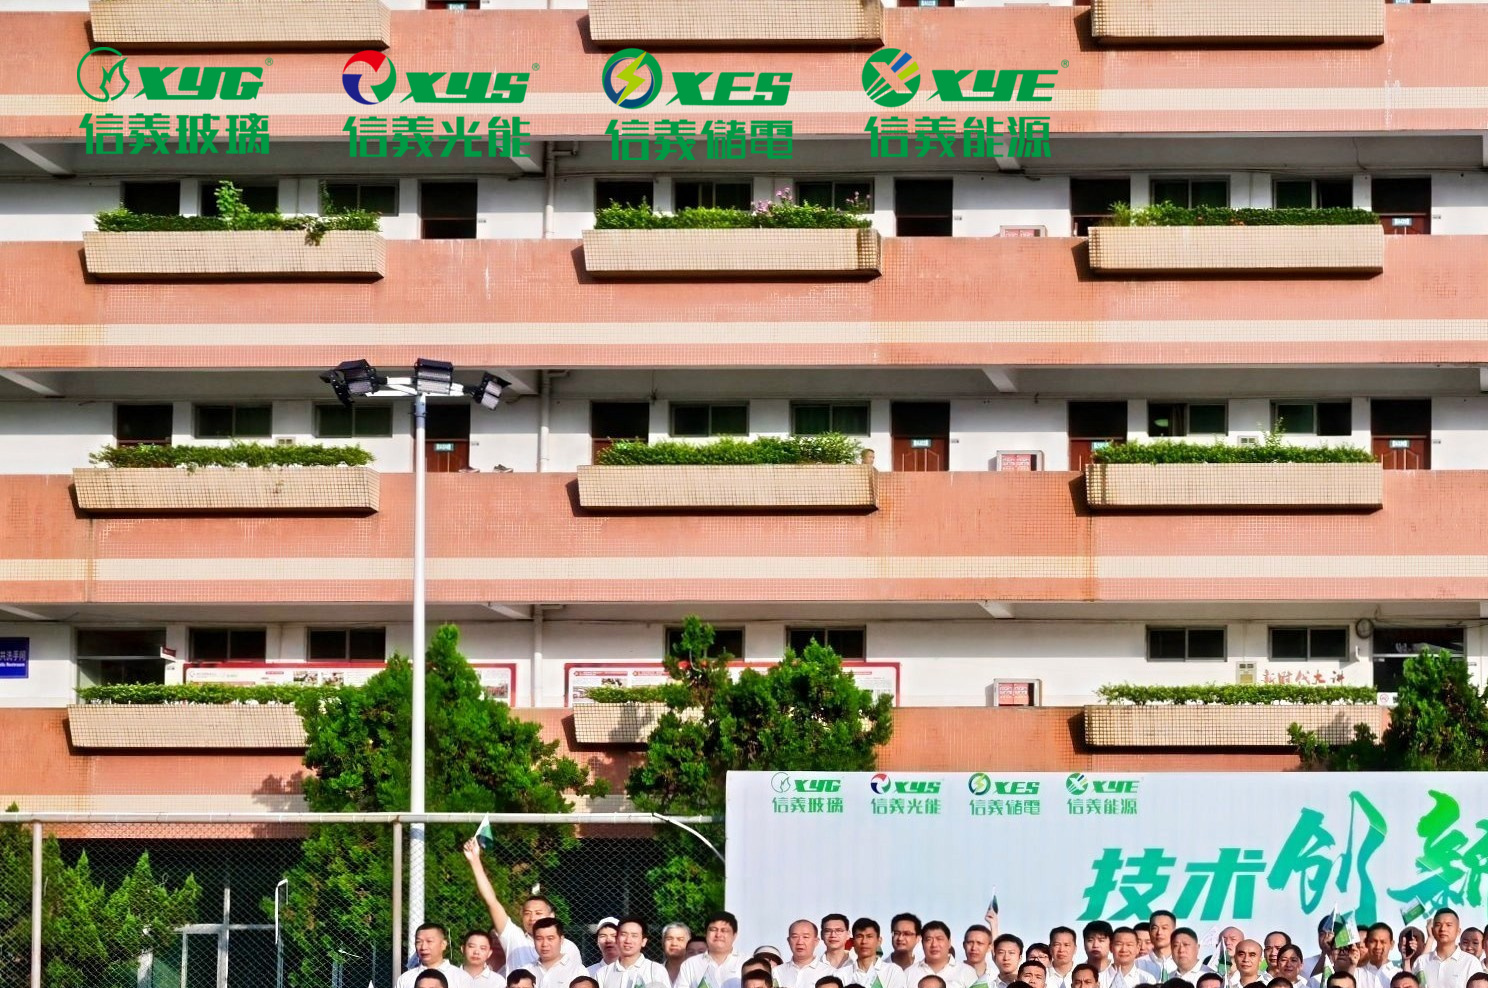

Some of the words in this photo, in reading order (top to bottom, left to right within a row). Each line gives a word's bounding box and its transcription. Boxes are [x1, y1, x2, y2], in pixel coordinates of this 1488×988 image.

[772, 796, 844, 814] 信義玻璃
[870, 798, 942, 815] 信義光能
[969, 799, 1041, 816] 信義儲電
[1067, 797, 1138, 816] 信義能源
